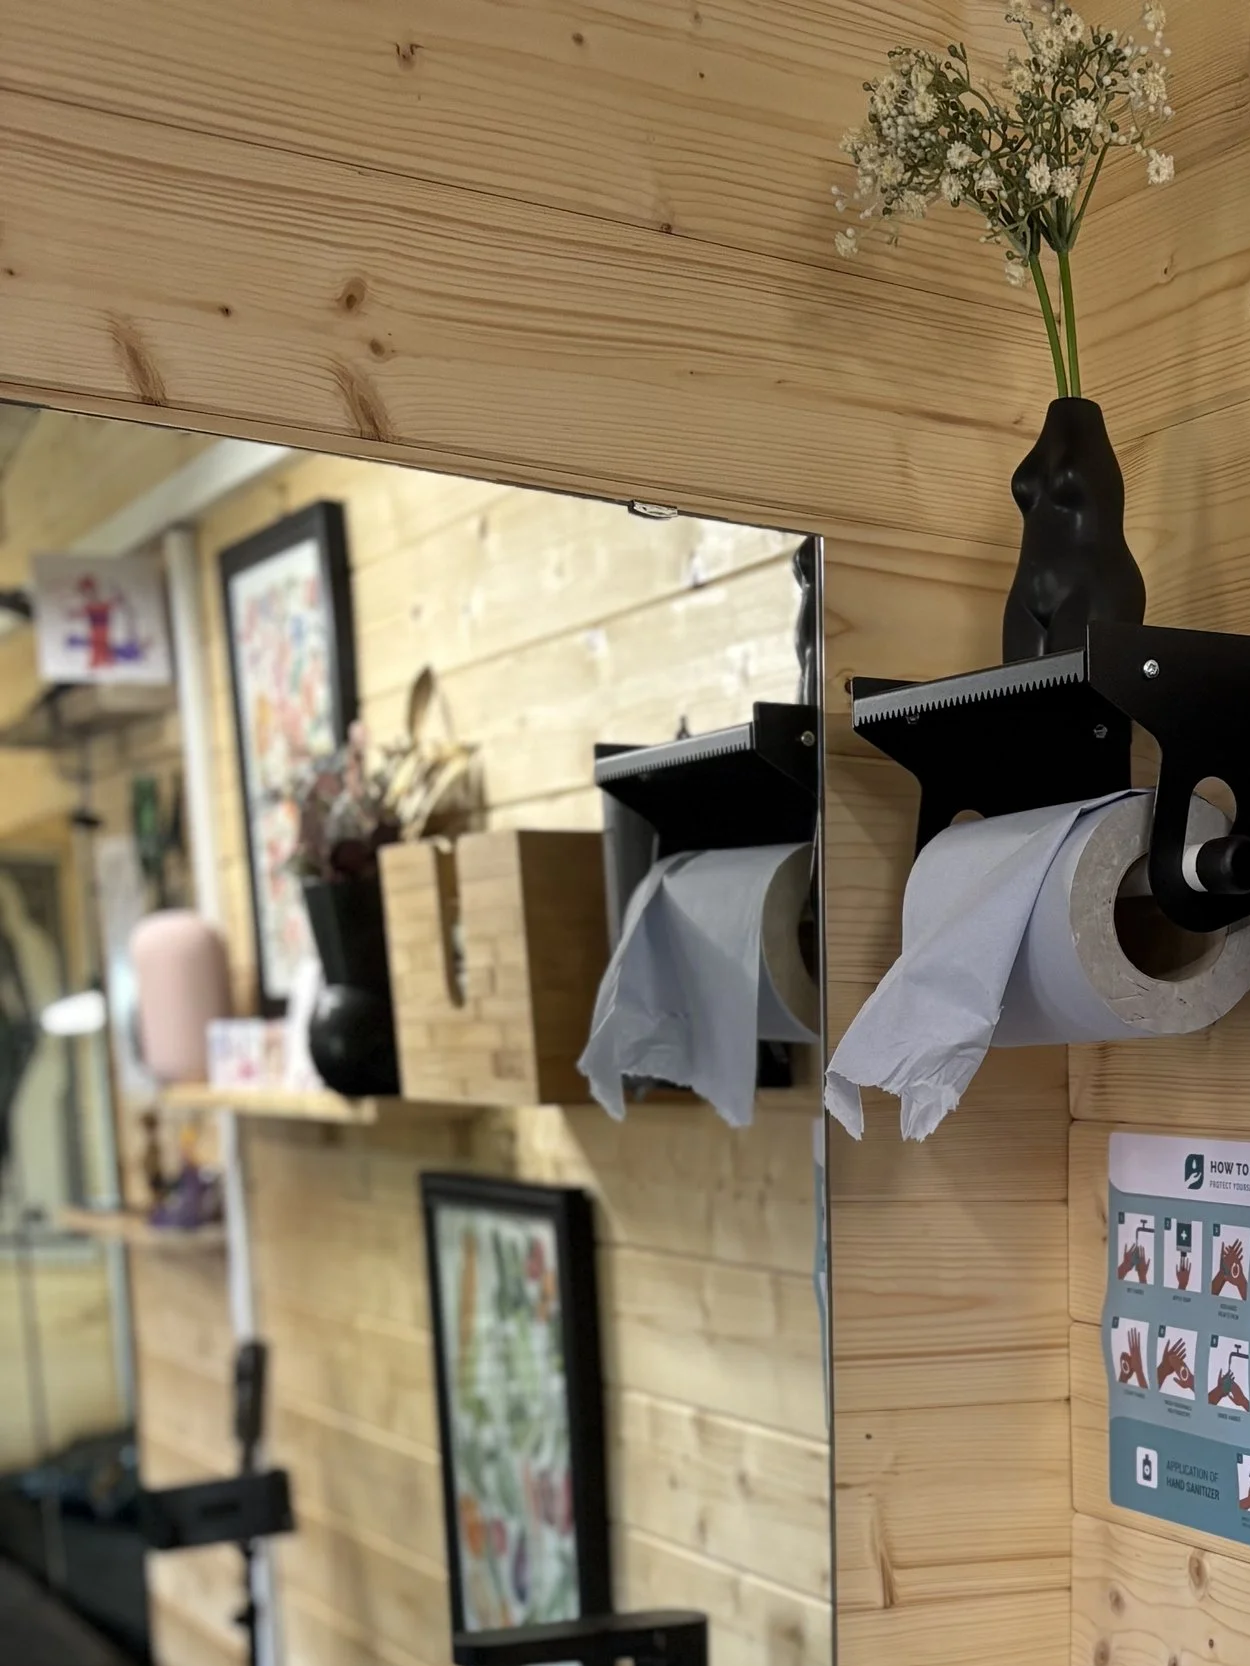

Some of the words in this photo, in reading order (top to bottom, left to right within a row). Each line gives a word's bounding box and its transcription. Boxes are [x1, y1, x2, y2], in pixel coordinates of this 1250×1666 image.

[1210, 1161, 1234, 1175] HOW
[1236, 1163, 1249, 1176] TO
[1210, 1180, 1232, 1190] PROTECT
[1166, 1460, 1209, 1481] APPLICATION
[1210, 1472, 1220, 1483] OF
[1166, 1477, 1185, 1491] HAND
[1186, 1482, 1220, 1501] SANITIZER
